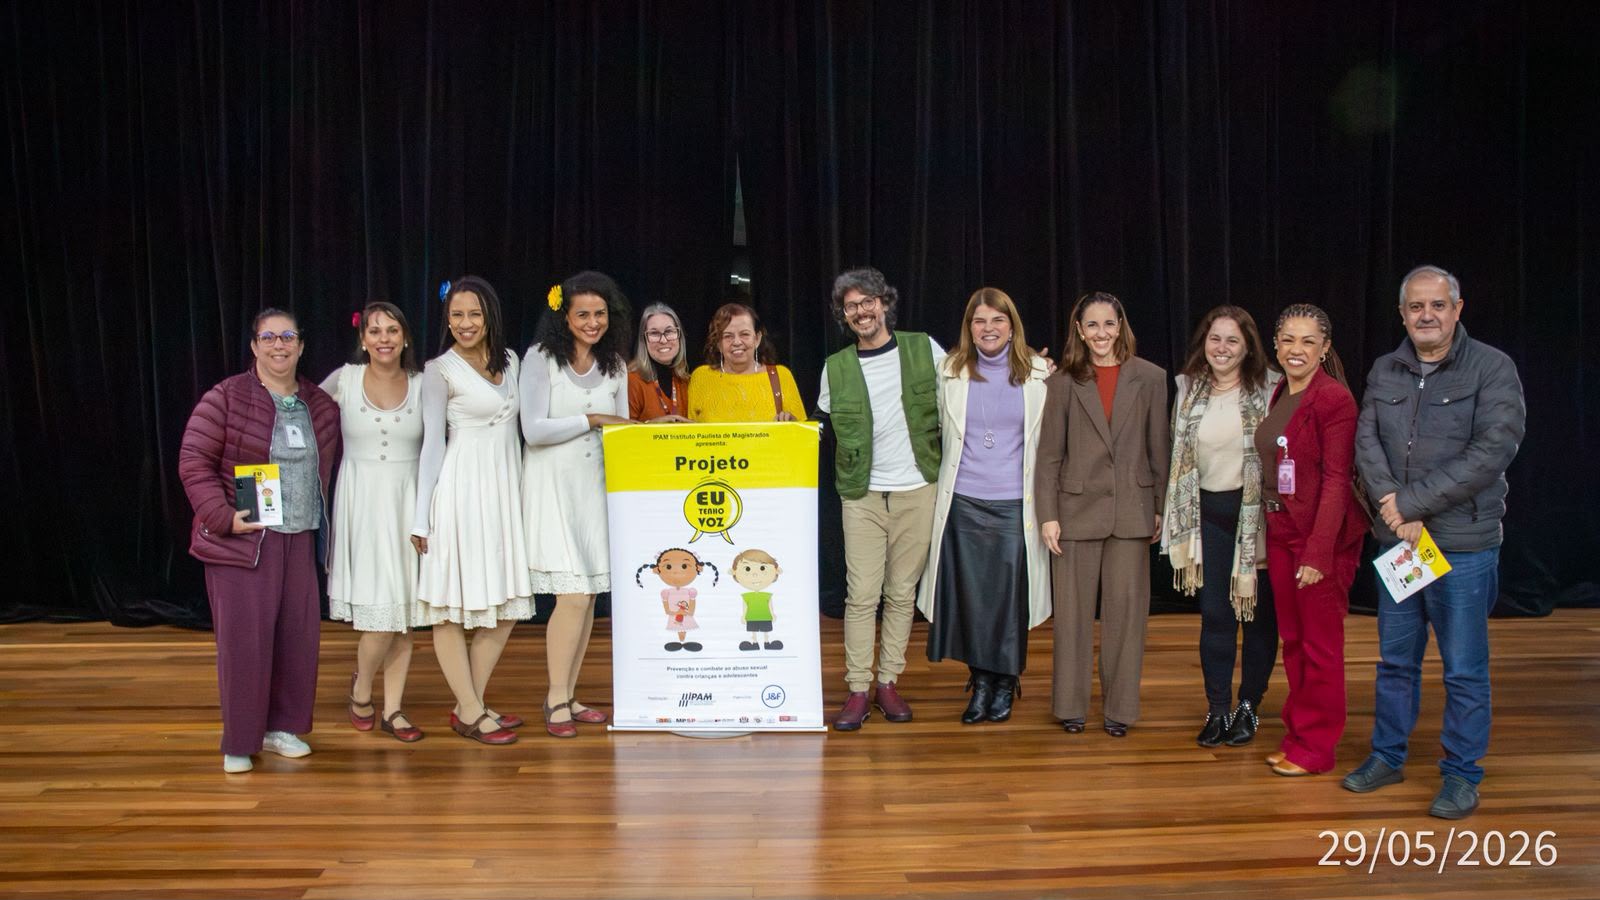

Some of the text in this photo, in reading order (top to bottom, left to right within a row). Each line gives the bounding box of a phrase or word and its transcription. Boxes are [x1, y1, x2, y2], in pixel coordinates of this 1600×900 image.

[675, 455, 749, 474] Projeto
[696, 491, 725, 505] EU
[698, 517, 724, 527] VOZ
[765, 692, 781, 701] J&F
